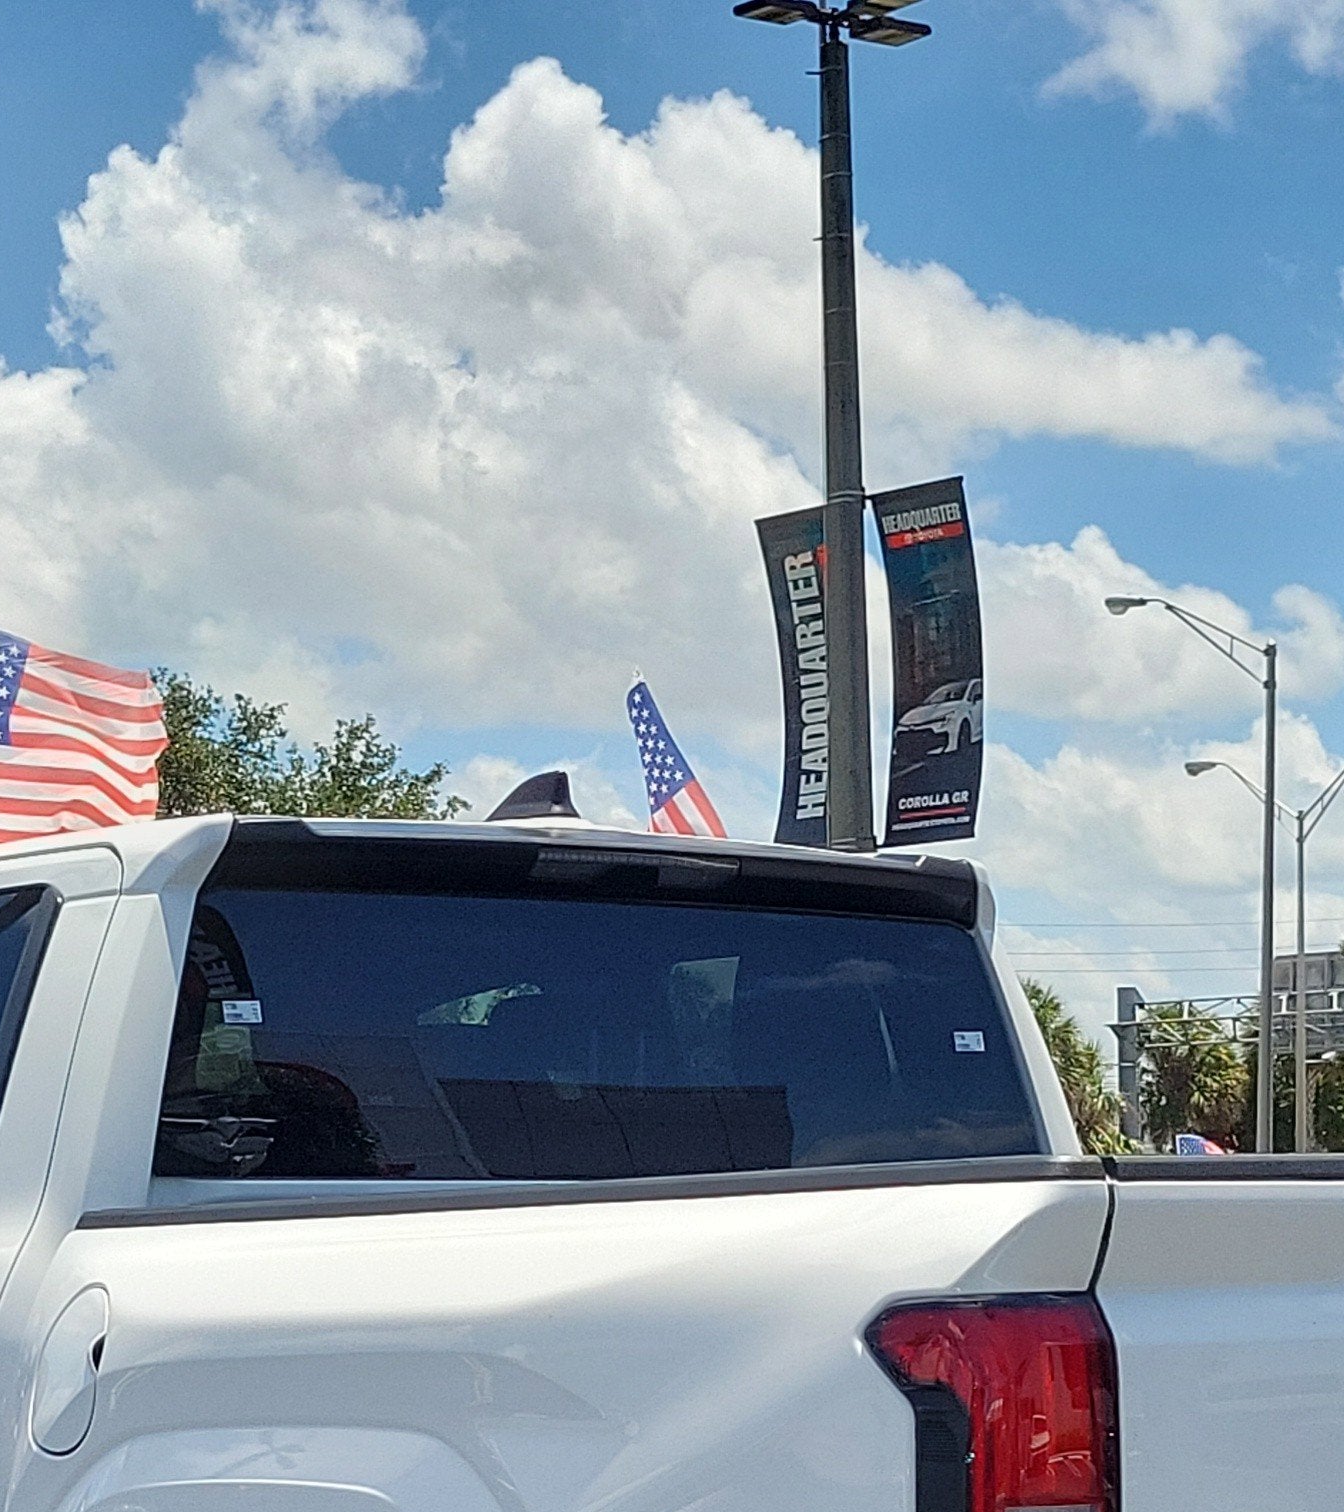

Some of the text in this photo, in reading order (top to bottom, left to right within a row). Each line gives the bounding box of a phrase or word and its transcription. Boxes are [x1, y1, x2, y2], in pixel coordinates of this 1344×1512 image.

[882, 502, 961, 534] HEADQUARTER
[785, 551, 828, 820] HEADQUARTER
[898, 790, 969, 809] COROLLA GR
